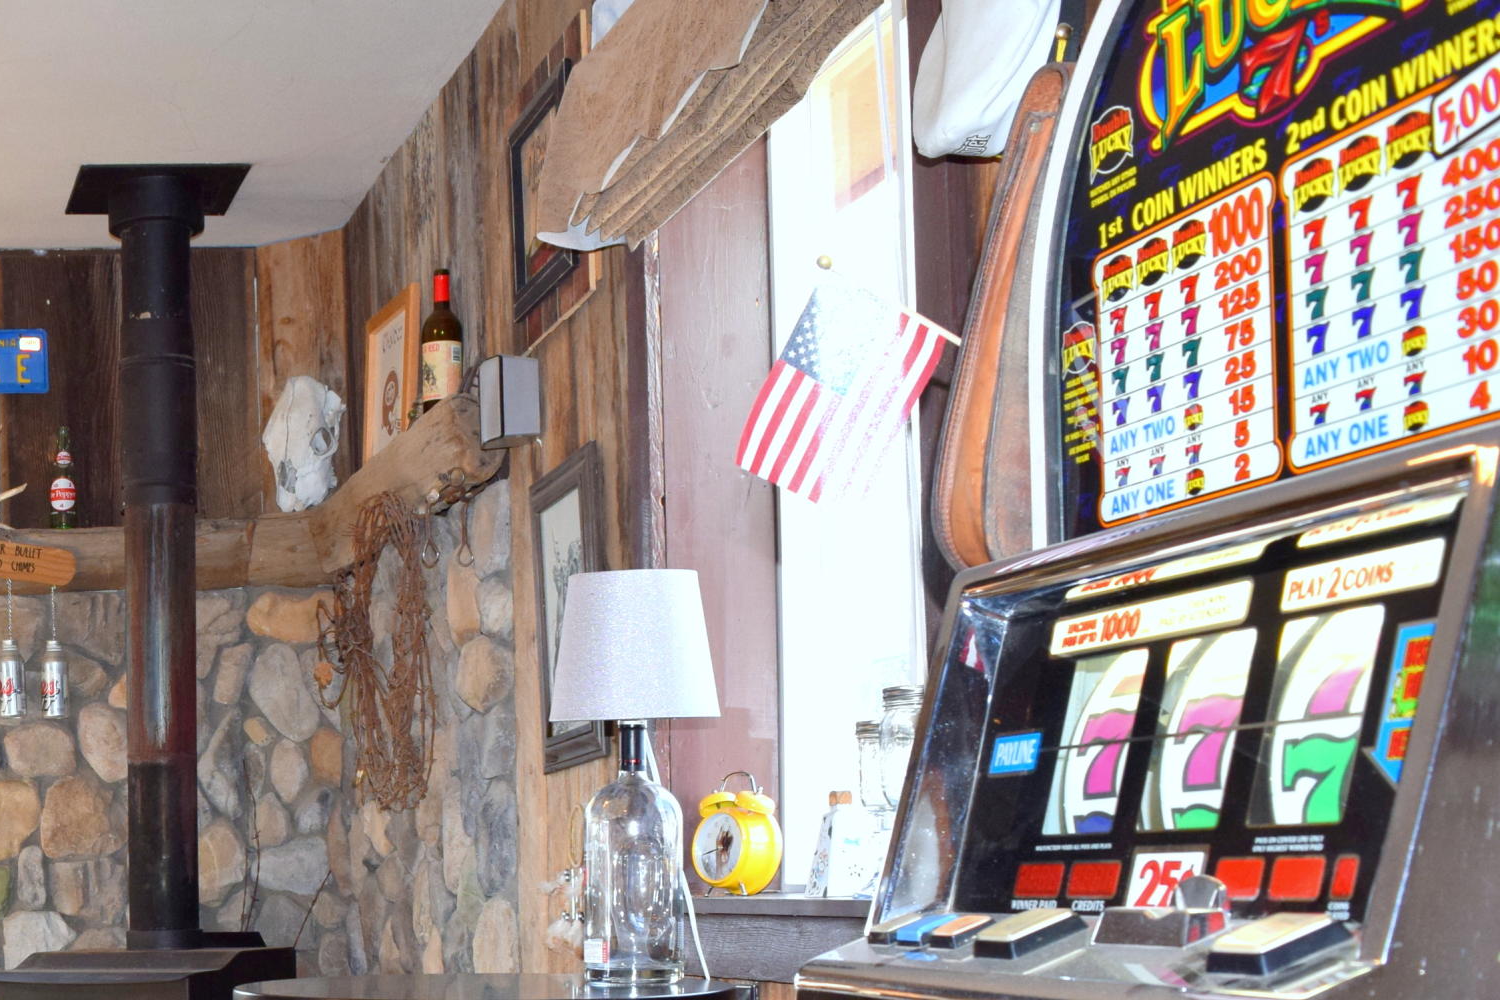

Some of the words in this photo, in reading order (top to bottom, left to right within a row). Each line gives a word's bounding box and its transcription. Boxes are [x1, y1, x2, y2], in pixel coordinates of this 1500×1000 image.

[1286, 107, 1326, 155] 2nd
[1331, 75, 1387, 130] COIN
[1442, 138, 1500, 186] 400
[1099, 216, 1123, 249] 1st
[1132, 187, 1174, 231] COIN
[1178, 138, 1267, 207] WINNERS
[1444, 178, 1500, 229] 250
[1209, 187, 1263, 257] 1000
[1449, 218, 1500, 264] 150
[1214, 247, 1262, 290] 200
[1456, 260, 1499, 300] 50
[1219, 281, 1261, 320] 125
[1225, 317, 1255, 351] 75
[1303, 357, 1340, 390] ANY
[1347, 340, 1390, 373] TWO
[1457, 299, 1500, 338] 30
[16, 354, 32, 384] E
[1225, 350, 1256, 385] 25
[1462, 339, 1499, 375] 10
[1110, 428, 1138, 455] ANY
[1143, 416, 1175, 442] TWO
[1229, 384, 1256, 416] 15
[1235, 419, 1250, 448] 5
[1304, 428, 1341, 459] ANY
[1349, 415, 1389, 445] ONE
[1469, 380, 1491, 411] 4
[1111, 489, 1140, 516] ANY
[1144, 479, 1175, 505] ONE
[1235, 453, 1251, 482] 2
[15, 545, 43, 559] BULLET
[1326, 567, 1341, 599] 2
[1342, 561, 1395, 591] COINS
[1101, 608, 1141, 642] 1000
[994, 739, 1037, 766] PAYLINE
[1071, 900, 1105, 911] CREDITS
